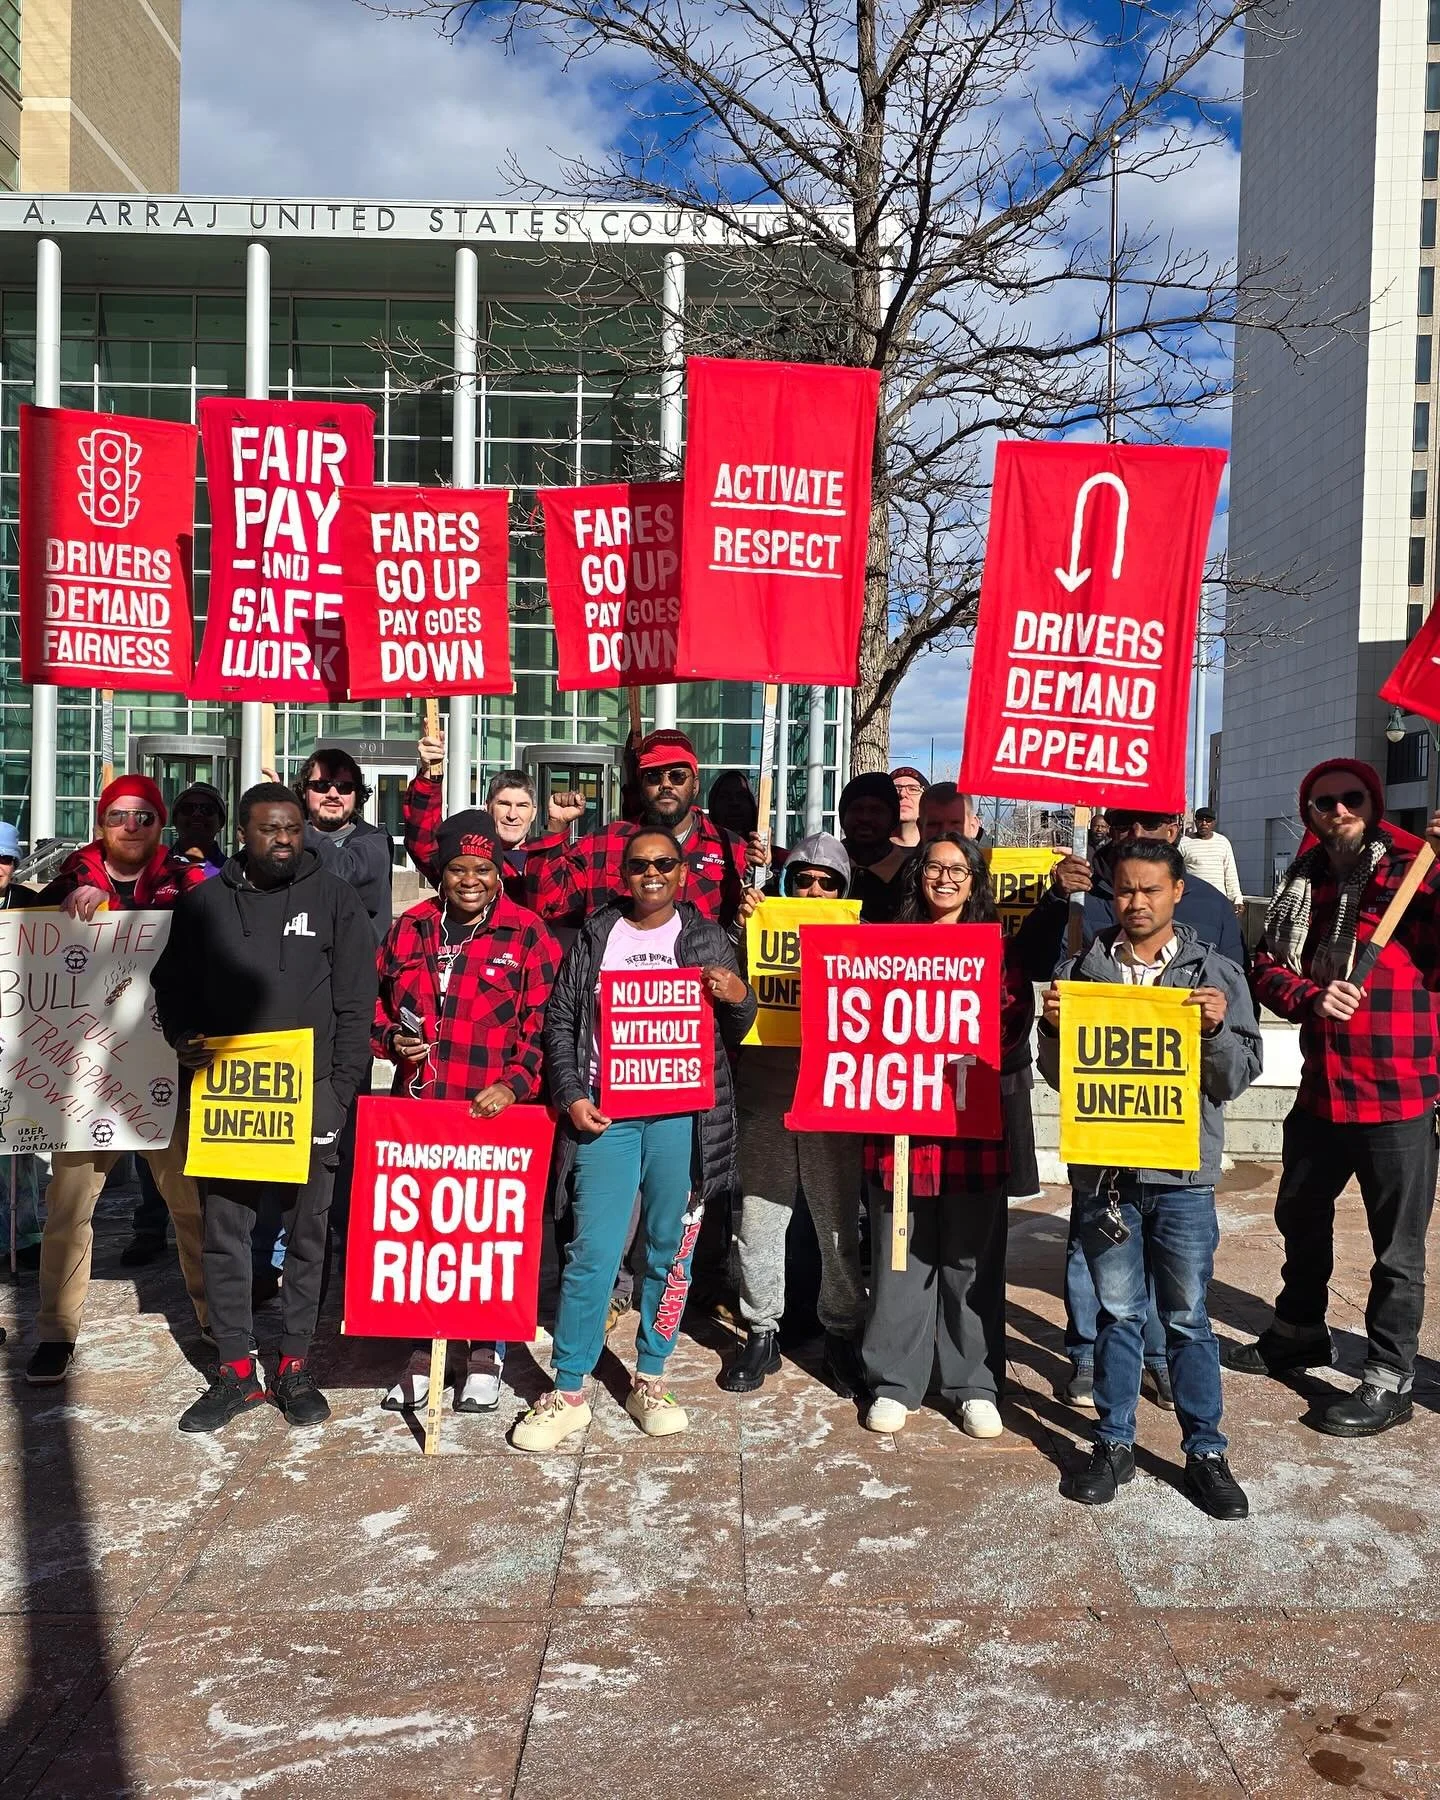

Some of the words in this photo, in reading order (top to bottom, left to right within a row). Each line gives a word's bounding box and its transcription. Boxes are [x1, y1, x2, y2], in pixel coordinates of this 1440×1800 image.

[22, 201, 56, 226] A.
[86, 203, 217, 229] ARRAJ
[250, 206, 396, 231] UNITED
[429, 207, 569, 236] STATES
[231, 425, 348, 486] FAIR
[714, 463, 845, 507] ACTIVATE
[234, 486, 341, 553] PAY
[370, 512, 480, 554] FARES
[573, 504, 674, 549] FARES
[46, 538, 171, 582] DRIVERS
[261, 551, 310, 582] AND
[713, 526, 842, 570] RESPECT
[375, 559, 426, 603] GO
[434, 558, 481, 601] UP
[581, 554, 626, 596] GO
[632, 550, 679, 592] UP
[46, 584, 170, 627] DEMAND
[229, 587, 343, 639] SAFE
[378, 608, 419, 637] PAY
[425, 607, 482, 635] GOES
[585, 602, 622, 629] PAY
[626, 596, 680, 626] GOES
[43, 630, 170, 668] FAIRNESS
[1013, 610, 1165, 660] DRIVERS
[221, 639, 338, 682] WORK
[380, 640, 485, 683] DOWN
[1005, 666, 1157, 720] DEMAND
[360, 742, 385, 755] 901
[995, 726, 1150, 777] APPEALS
[88, 920, 156, 954] THE
[761, 930, 800, 964] UB
[759, 975, 800, 1005] UNF
[823, 955, 985, 982] TRANSPARENCY
[0, 970, 90, 1018] BULL
[612, 981, 641, 1005] NO
[644, 980, 701, 1005] UBER
[67, 1012, 129, 1062] FULL
[611, 1020, 701, 1043] WITHOUT
[828, 986, 871, 1043] IS
[882, 988, 981, 1045] OUR
[1078, 1026, 1182, 1068] UBER
[8, 1057, 94, 1123] NOW!!!
[18, 1014, 167, 1144] TRANSPARENCY
[206, 1059, 295, 1099] UBER
[611, 1057, 701, 1083] DRIVERS
[823, 1051, 977, 1111] RIGHT
[1077, 1083, 1182, 1116] UNFAIR
[18, 1126, 44, 1136] UBER
[20, 1134, 48, 1143] LYFT
[204, 1108, 294, 1138] UNFAIR
[12, 1141, 68, 1153] DOORDASH
[375, 1140, 533, 1172] TRANSPARENCY
[373, 1173, 420, 1233] IS
[431, 1176, 527, 1234] OUR
[371, 1240, 524, 1304] RIGHT
[652, 1273, 689, 1342] JERRY
